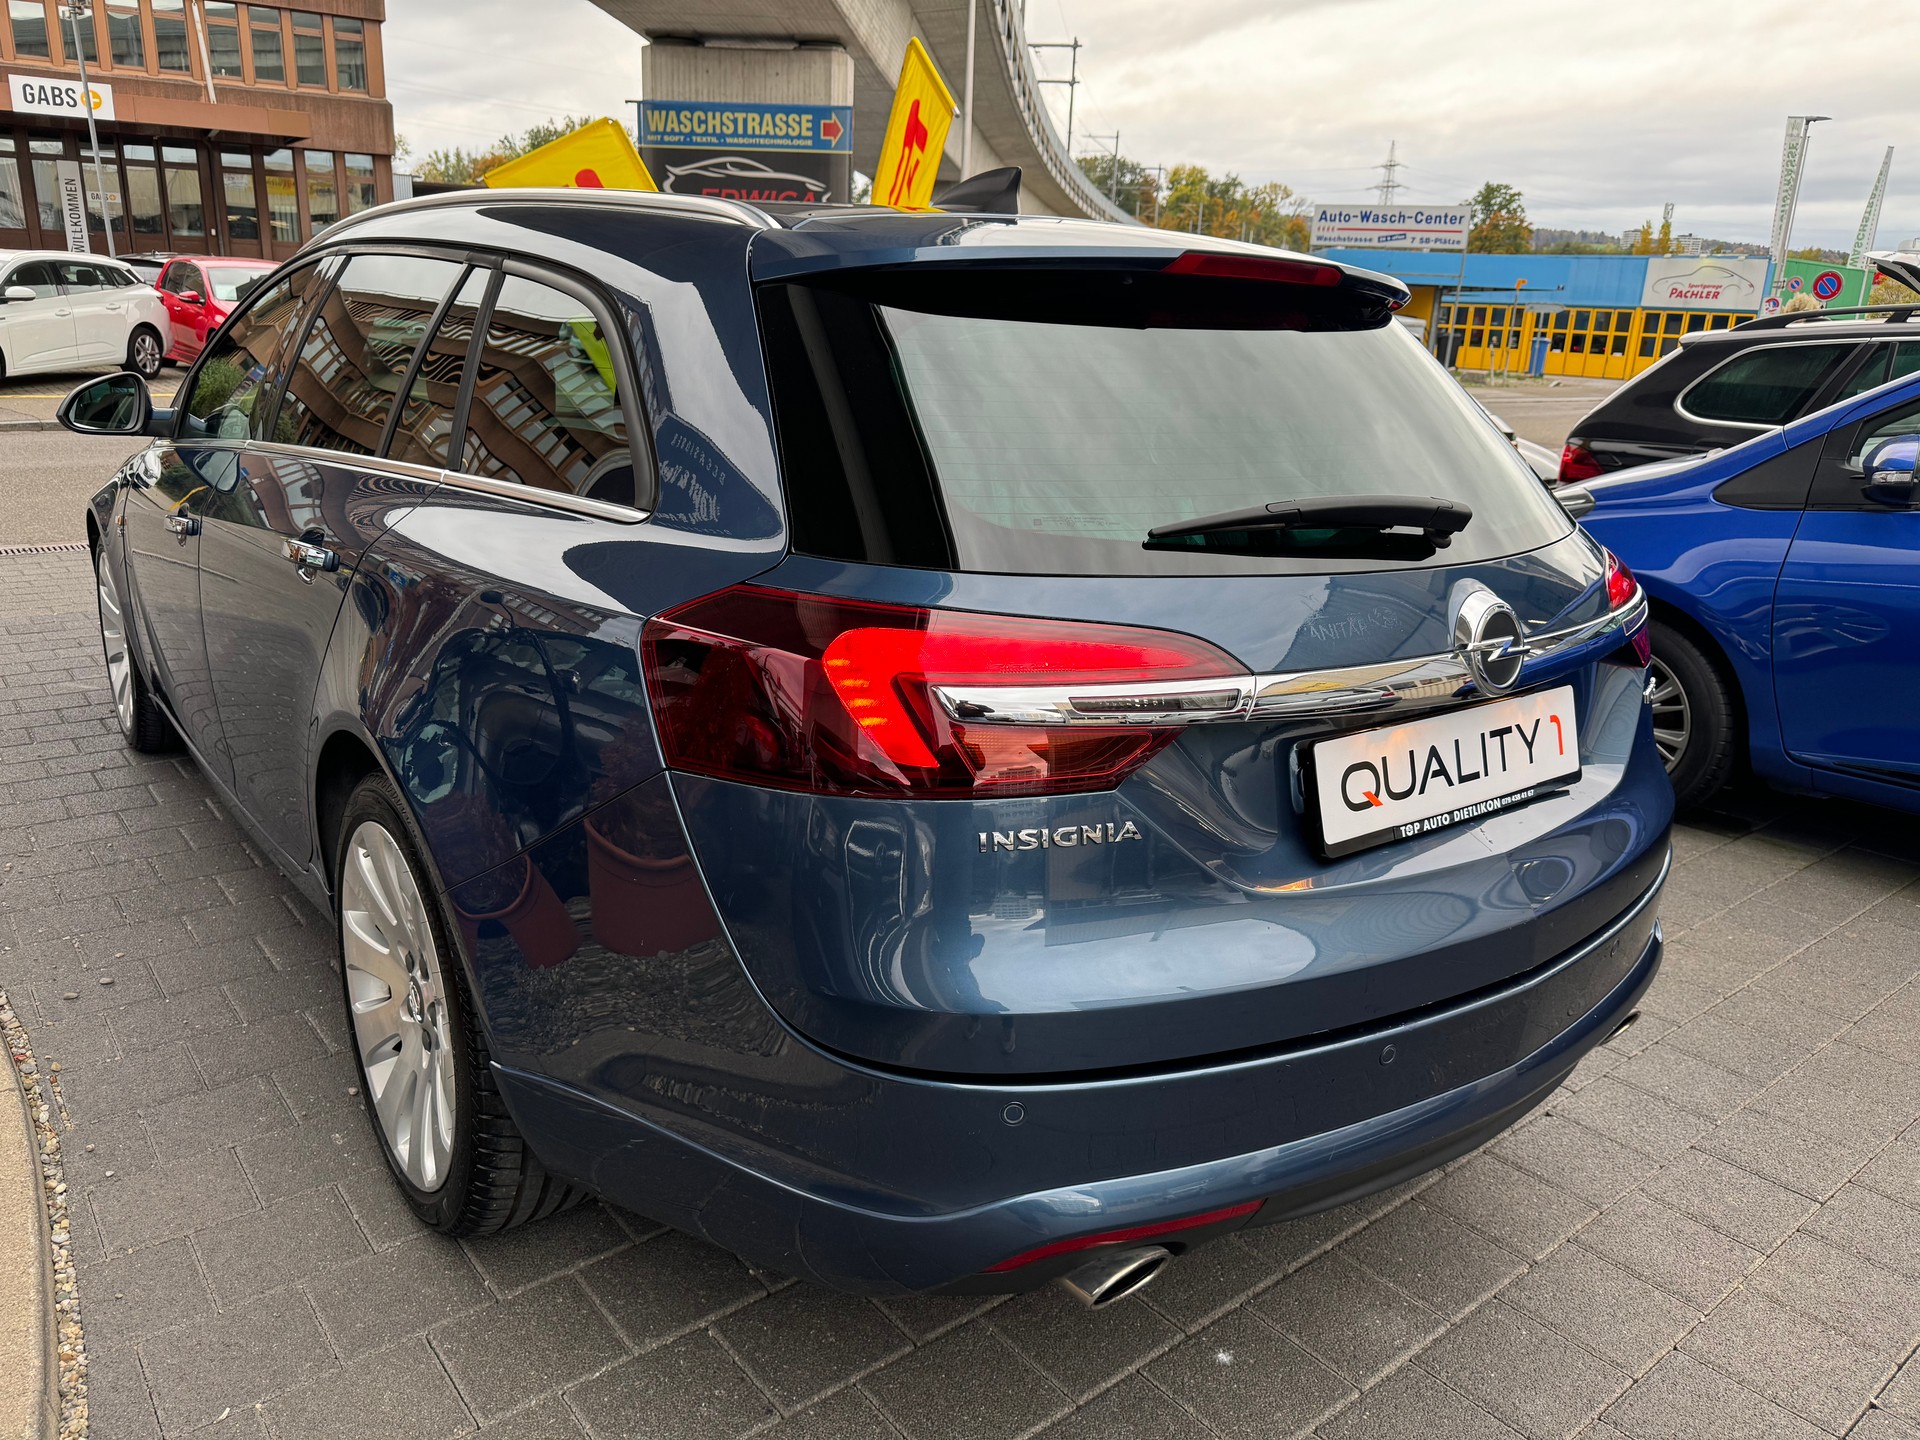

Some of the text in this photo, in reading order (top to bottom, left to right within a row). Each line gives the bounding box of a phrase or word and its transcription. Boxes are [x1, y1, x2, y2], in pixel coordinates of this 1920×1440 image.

[22, 83, 78, 108] GABS
[646, 110, 813, 136] WASCHSTRASSE
[725, 137, 813, 146] WASCHTECHNOLOGIE
[91, 193, 109, 201] GAS
[64, 178, 86, 253] WILLKOMMEN
[1318, 210, 1465, 225] Auto-Wasch-Center
[1316, 235, 1373, 243] Waschstrasse
[1669, 288, 1720, 299] PACHLER
[1400, 824, 1421, 838] TOP
[1423, 814, 1450, 831] AUTO
[1453, 798, 1501, 822] DIETLIKON
[978, 820, 1143, 853] INSIGNIA
